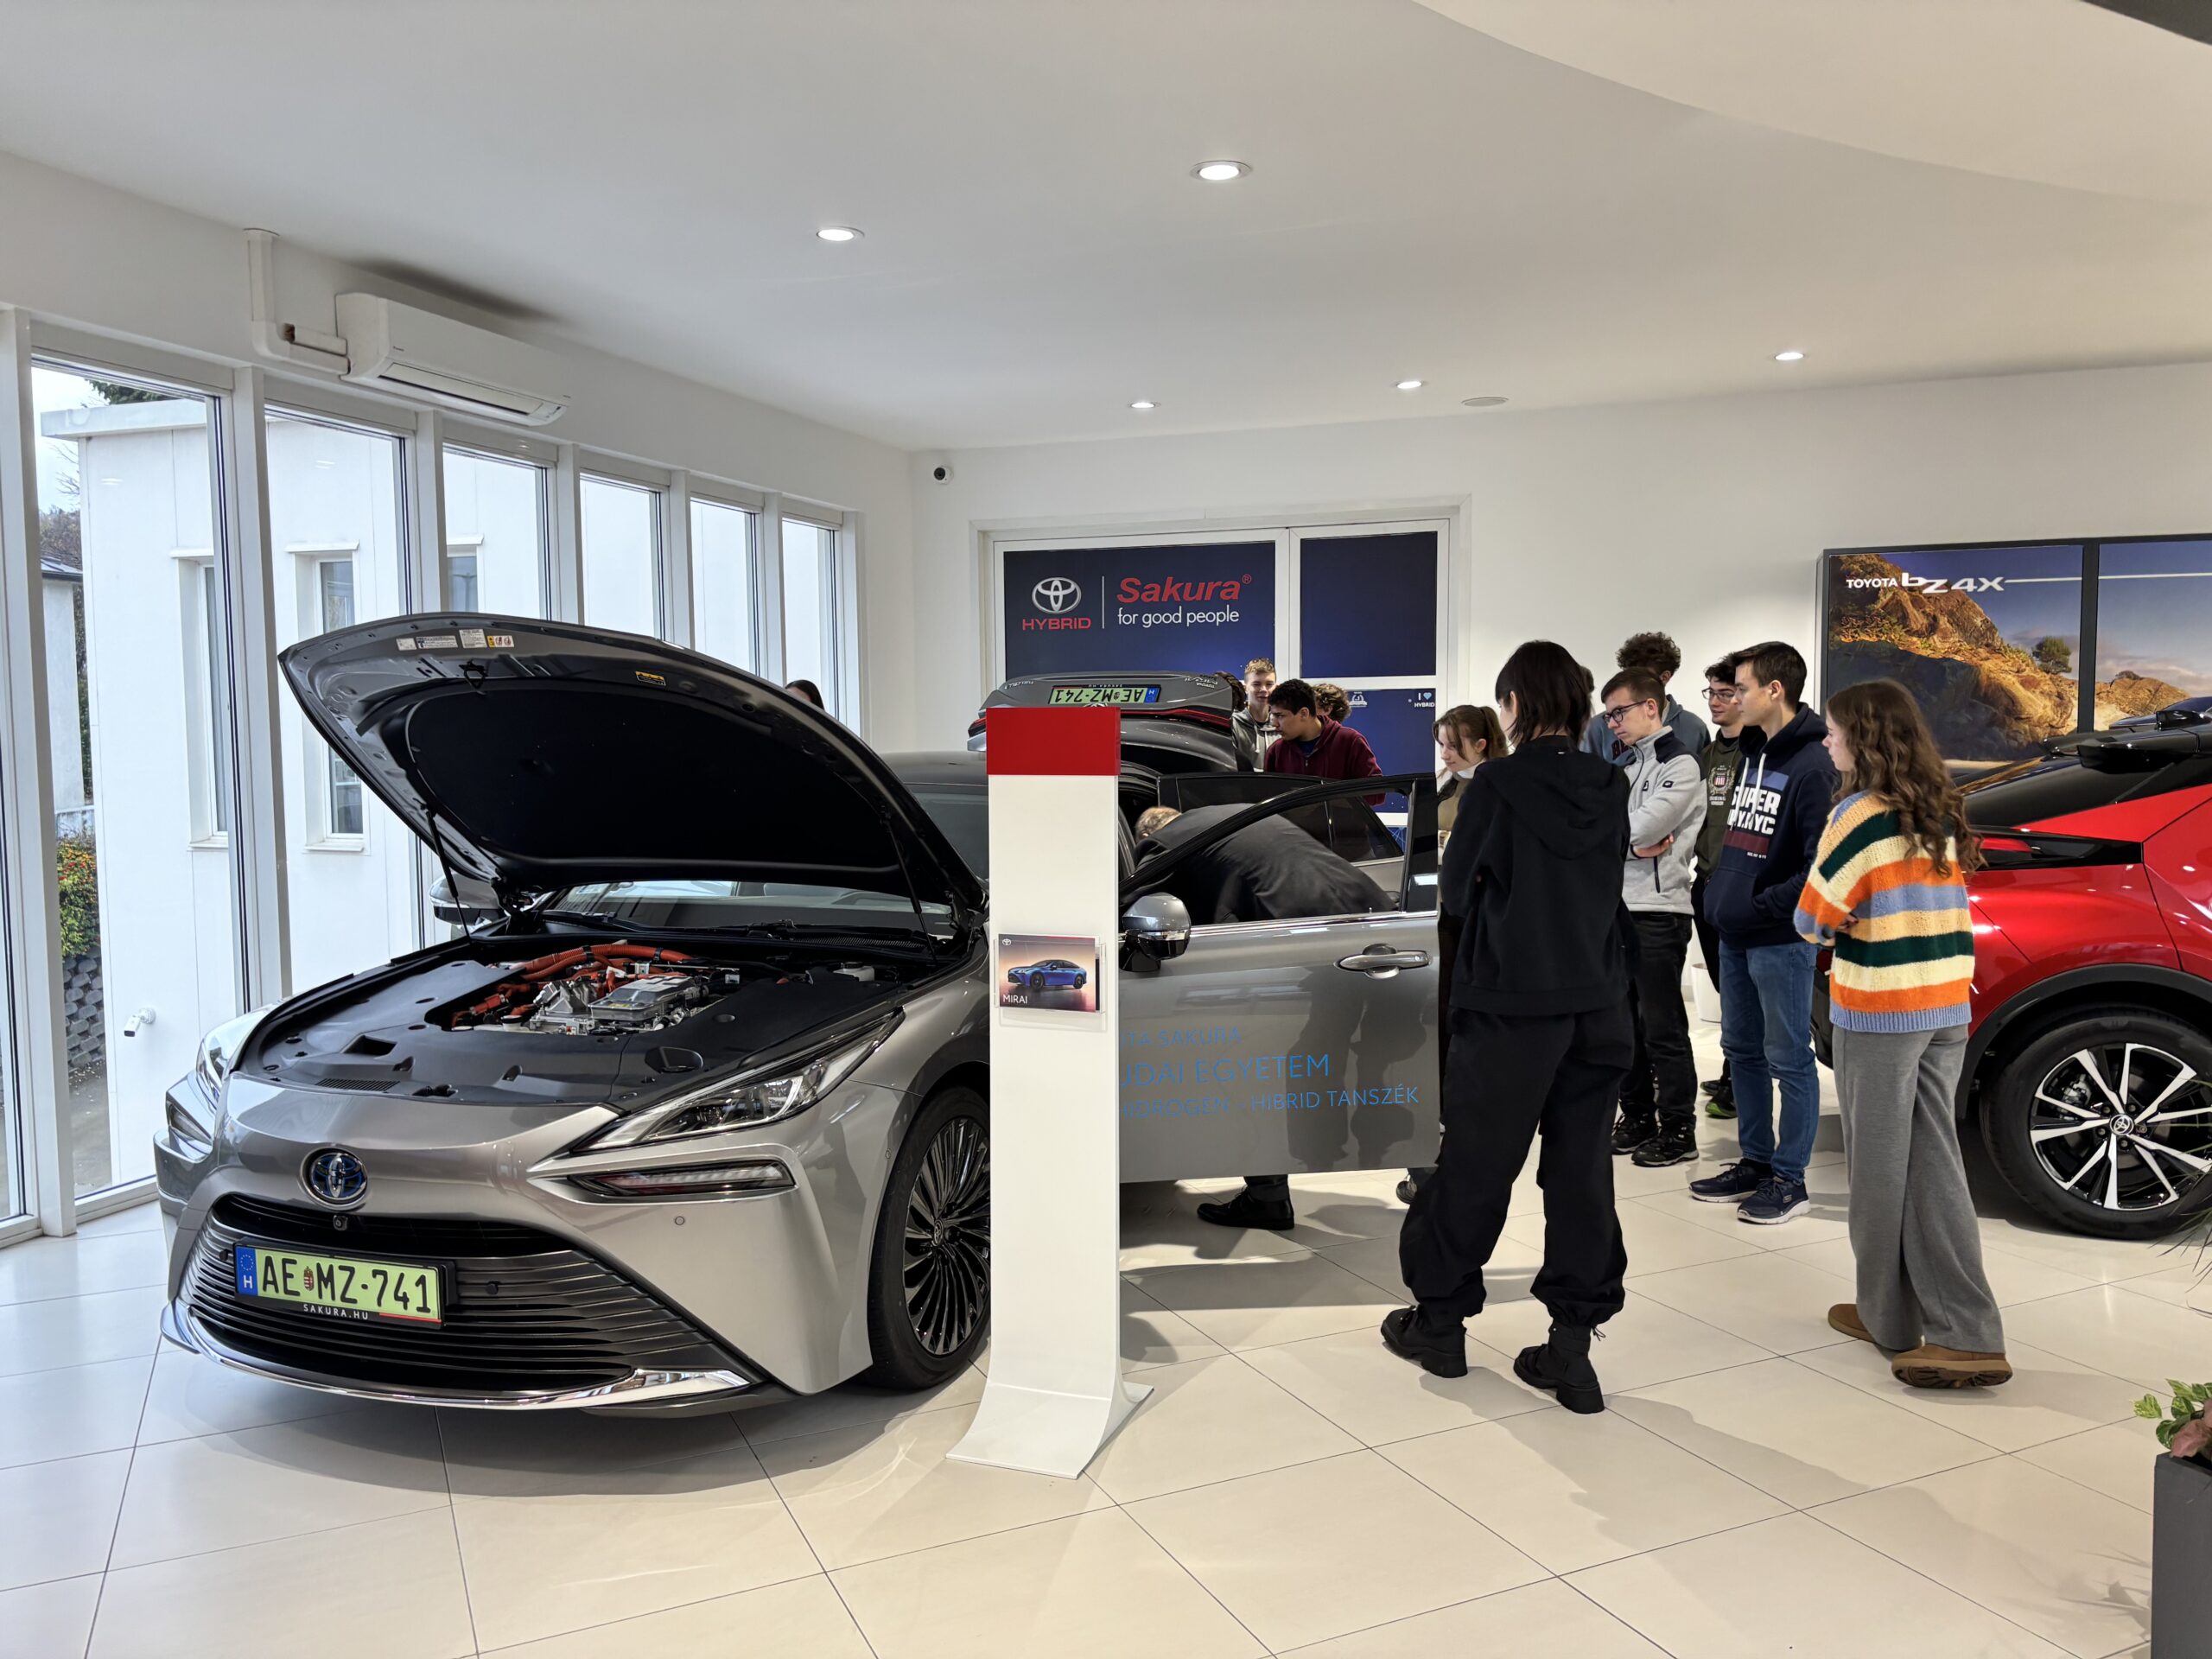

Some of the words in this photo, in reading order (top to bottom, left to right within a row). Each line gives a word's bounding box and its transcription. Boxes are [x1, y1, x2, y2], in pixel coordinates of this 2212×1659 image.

[1846, 577, 1898, 589] TOYOTA
[1021, 617, 1092, 631] HYBRID
[1117, 607, 1138, 625] for
[1141, 606, 1182, 628] good
[1186, 604, 1240, 626] people
[1054, 690, 1114, 702] MZ-741
[1121, 690, 1144, 702] AE
[1002, 994, 1028, 1004] MIRAI
[1157, 1026, 1243, 1048] SAKURA
[1195, 1053, 1329, 1083] EGYETEM
[1252, 1090, 1320, 1111] HIBRID
[1326, 1083, 1420, 1107] TANSZÉK
[243, 1274, 253, 1289] H
[262, 1255, 301, 1296] AE
[315, 1262, 432, 1313] MZ-741
[303, 1303, 369, 1320] SAKURA.HU
